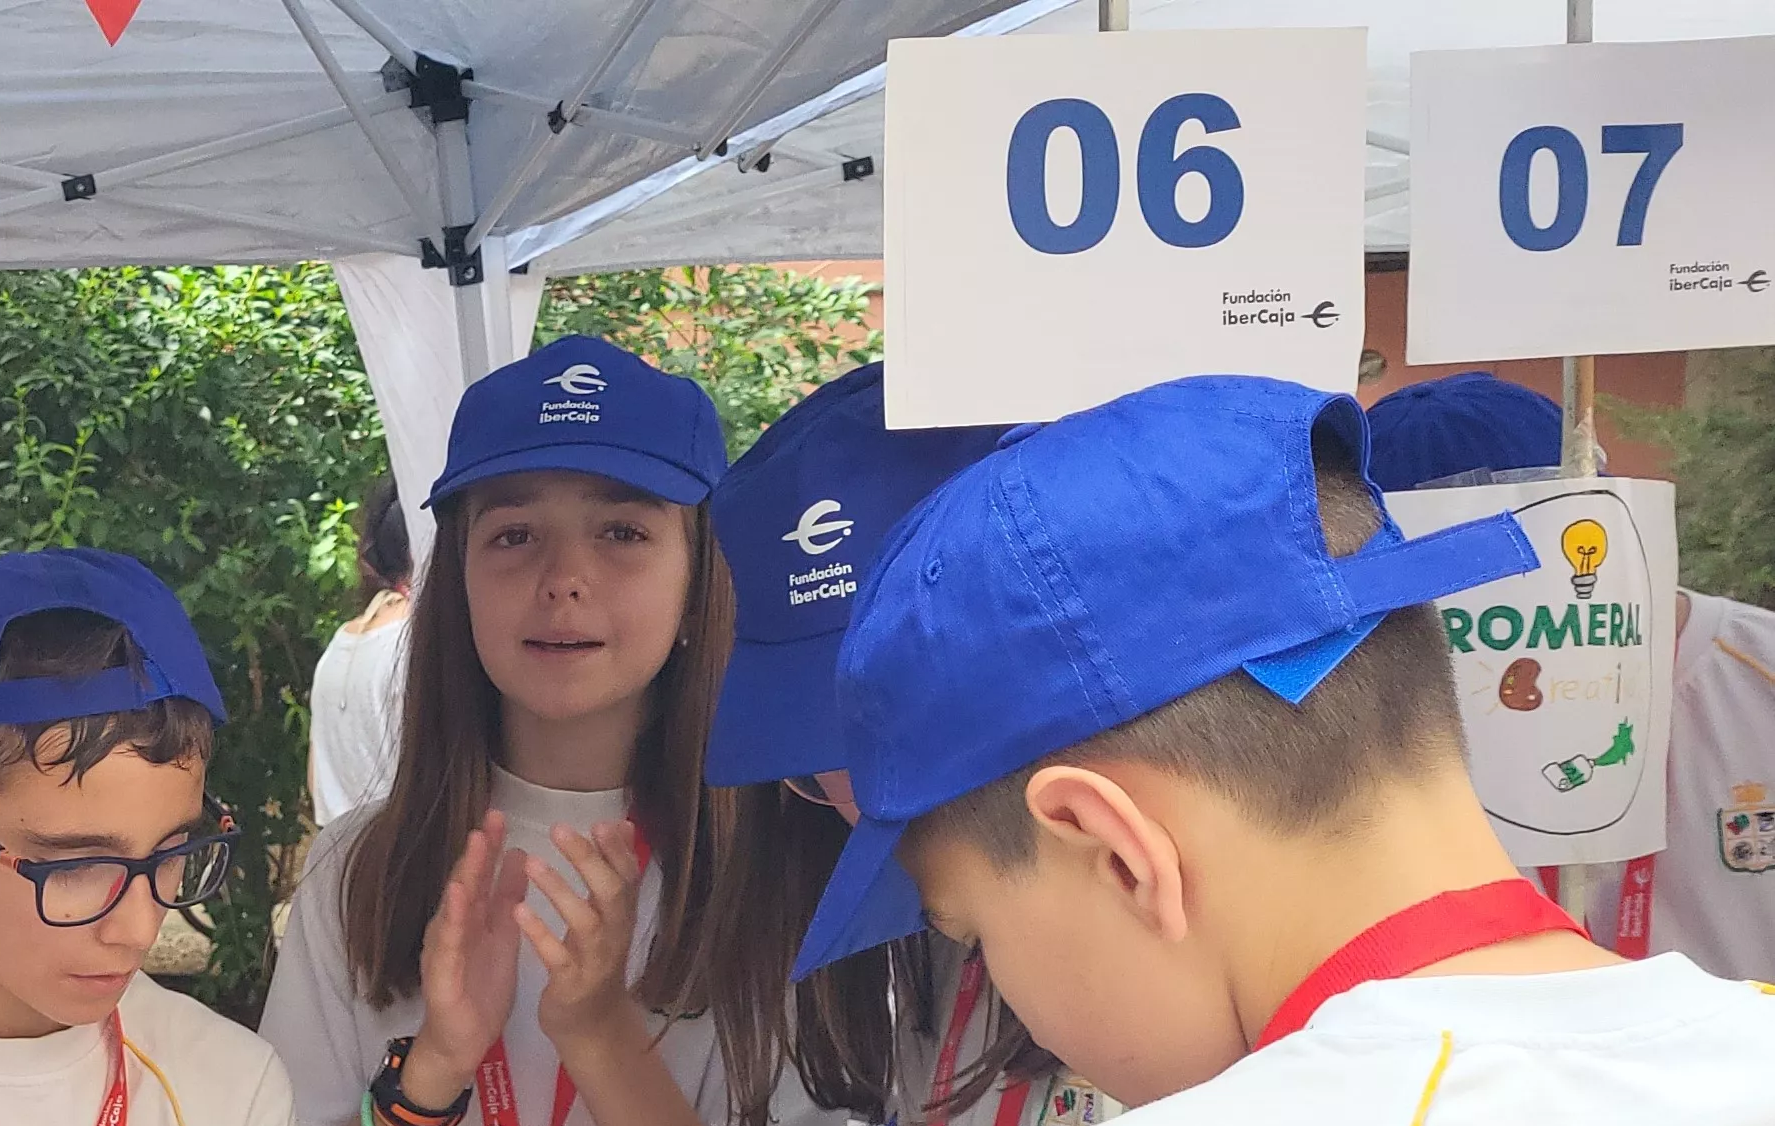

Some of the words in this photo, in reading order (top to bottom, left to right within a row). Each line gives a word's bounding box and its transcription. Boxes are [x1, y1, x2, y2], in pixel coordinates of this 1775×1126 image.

[1006, 93, 1244, 255] 06
[1499, 123, 1684, 252] 07
[1670, 260, 1730, 274] Fundación
[1669, 276, 1733, 292] iberCaja
[1222, 289, 1291, 304] Fundación
[1222, 307, 1295, 327] iberCaja
[542, 400, 600, 411] Fundación
[539, 411, 600, 424] iberCaja
[789, 562, 853, 587] Fundación
[789, 579, 857, 605] iberCaja
[1441, 602, 1643, 654] ROMERAL
